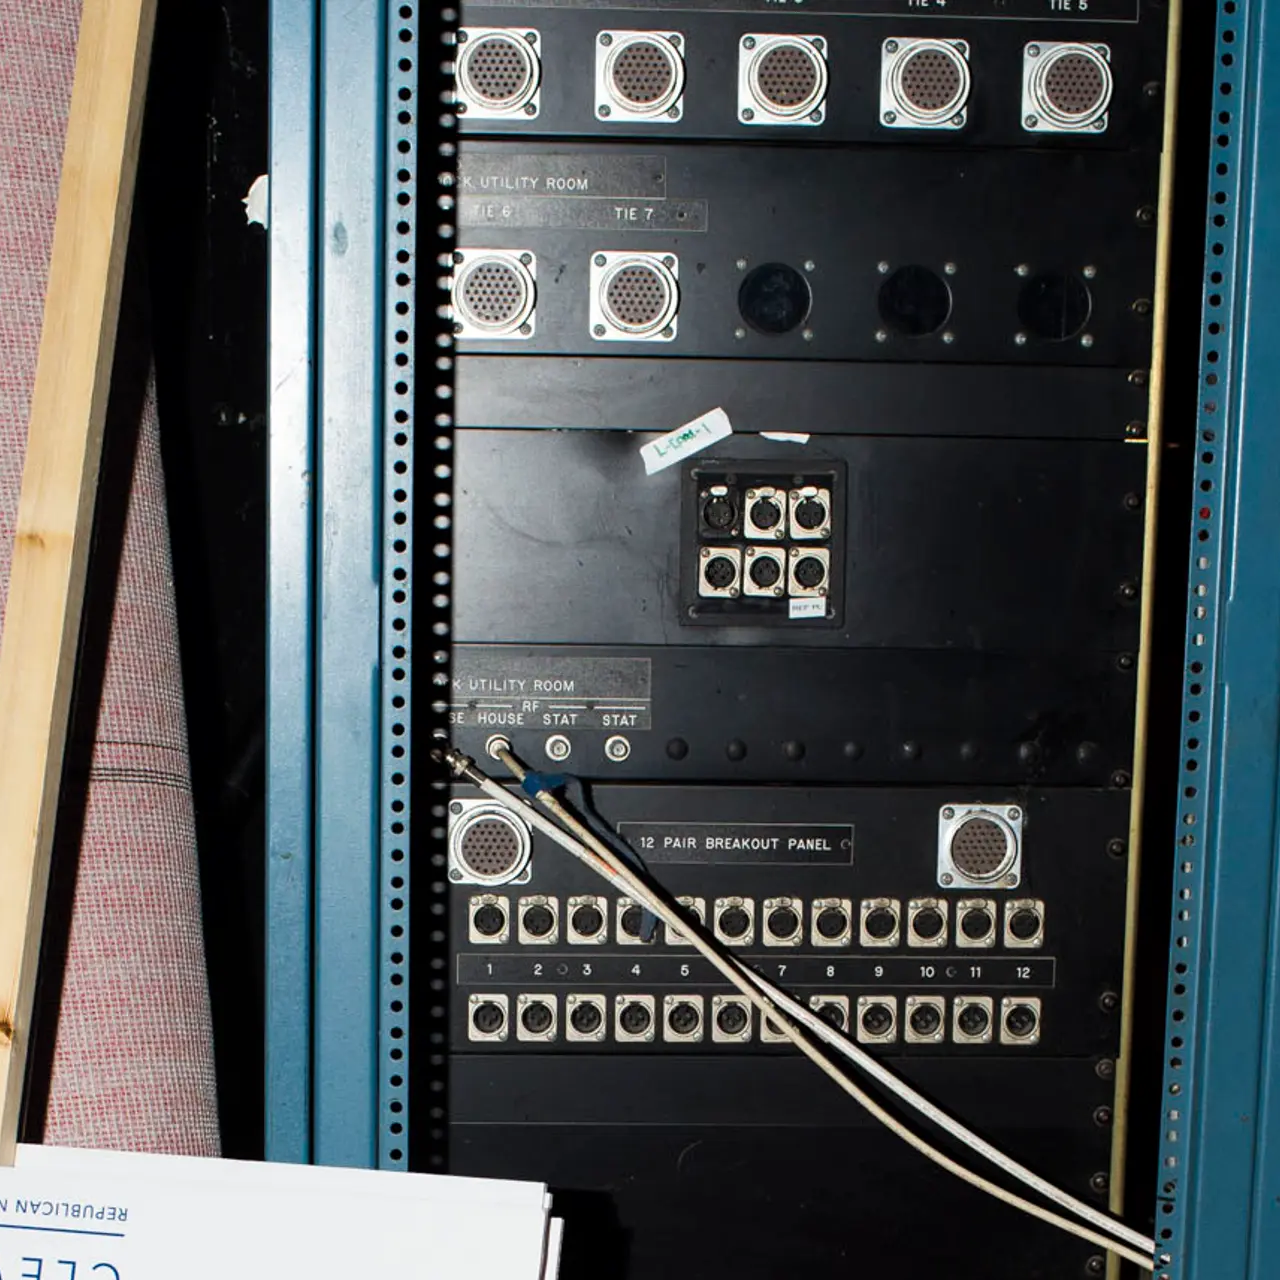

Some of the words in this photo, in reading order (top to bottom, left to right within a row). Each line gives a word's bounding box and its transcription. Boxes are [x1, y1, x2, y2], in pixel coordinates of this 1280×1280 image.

[1078, 0, 1089, 11] 5
[480, 176, 538, 189] UTILITY
[546, 178, 589, 190] ROOM
[473, 206, 494, 217] TIE
[501, 206, 512, 218] 6
[615, 207, 637, 220] TIE
[644, 208, 655, 220] 7
[470, 679, 524, 692] UTILITY
[534, 680, 575, 692] ROOM
[522, 701, 539, 713] RF
[478, 713, 524, 725] HOUSE
[543, 713, 578, 725] STAT
[602, 715, 638, 726] STAT
[640, 836, 654, 848] 12
[664, 836, 697, 849] PAIR
[705, 838, 780, 850] BREAKOUT
[788, 838, 831, 851] PANEL
[487, 964, 493, 975] 1
[533, 964, 543, 976] 2
[582, 964, 592, 976] 3
[631, 965, 641, 976] 4
[680, 965, 690, 977] 5
[777, 965, 787, 976] 7
[826, 966, 835, 977] 8
[874, 966, 884, 977] 9
[920, 966, 935, 978] 10
[970, 967, 981, 978] 11
[1016, 967, 1031, 979] 12
[15, 1200, 129, 1222] REPUBLICAN
